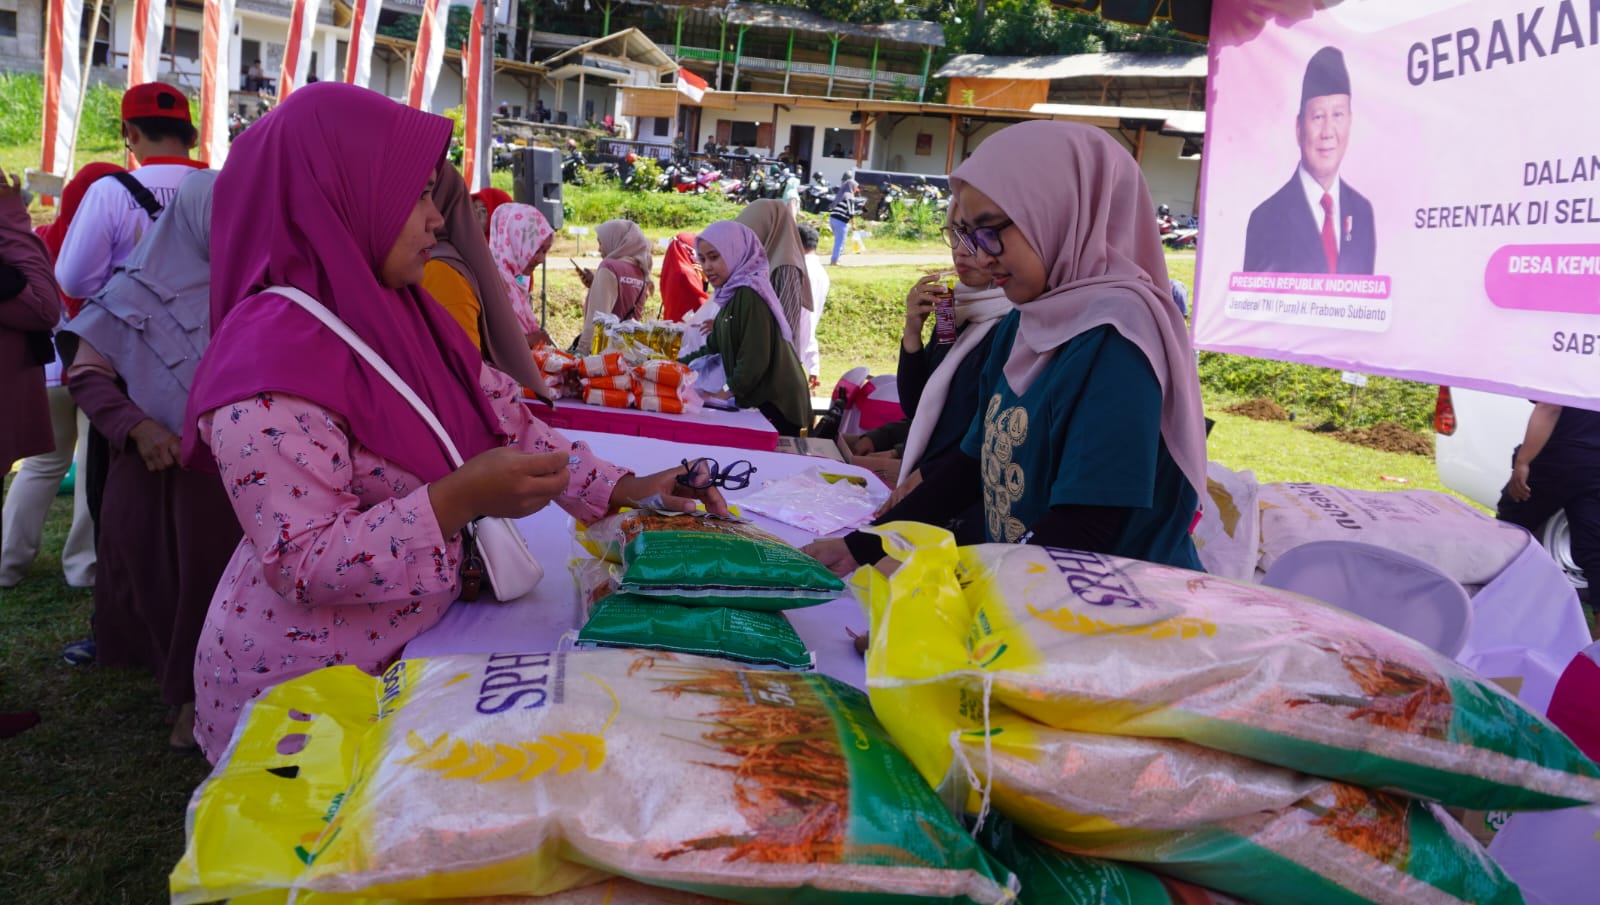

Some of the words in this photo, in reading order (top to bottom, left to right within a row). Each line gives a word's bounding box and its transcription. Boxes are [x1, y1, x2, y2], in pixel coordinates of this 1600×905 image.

[1415, 202, 1522, 229] SERENTAK
[1527, 200, 1549, 225] DI
[1508, 256, 1553, 274] DESA
[1232, 276, 1275, 289] PRESIDEN
[1277, 277, 1323, 291] REPUBLIK
[1325, 280, 1387, 294] INDONESIA
[1310, 302, 1346, 318] Prabowo
[1347, 305, 1387, 321] Subianto
[1552, 331, 1600, 356] SAB
